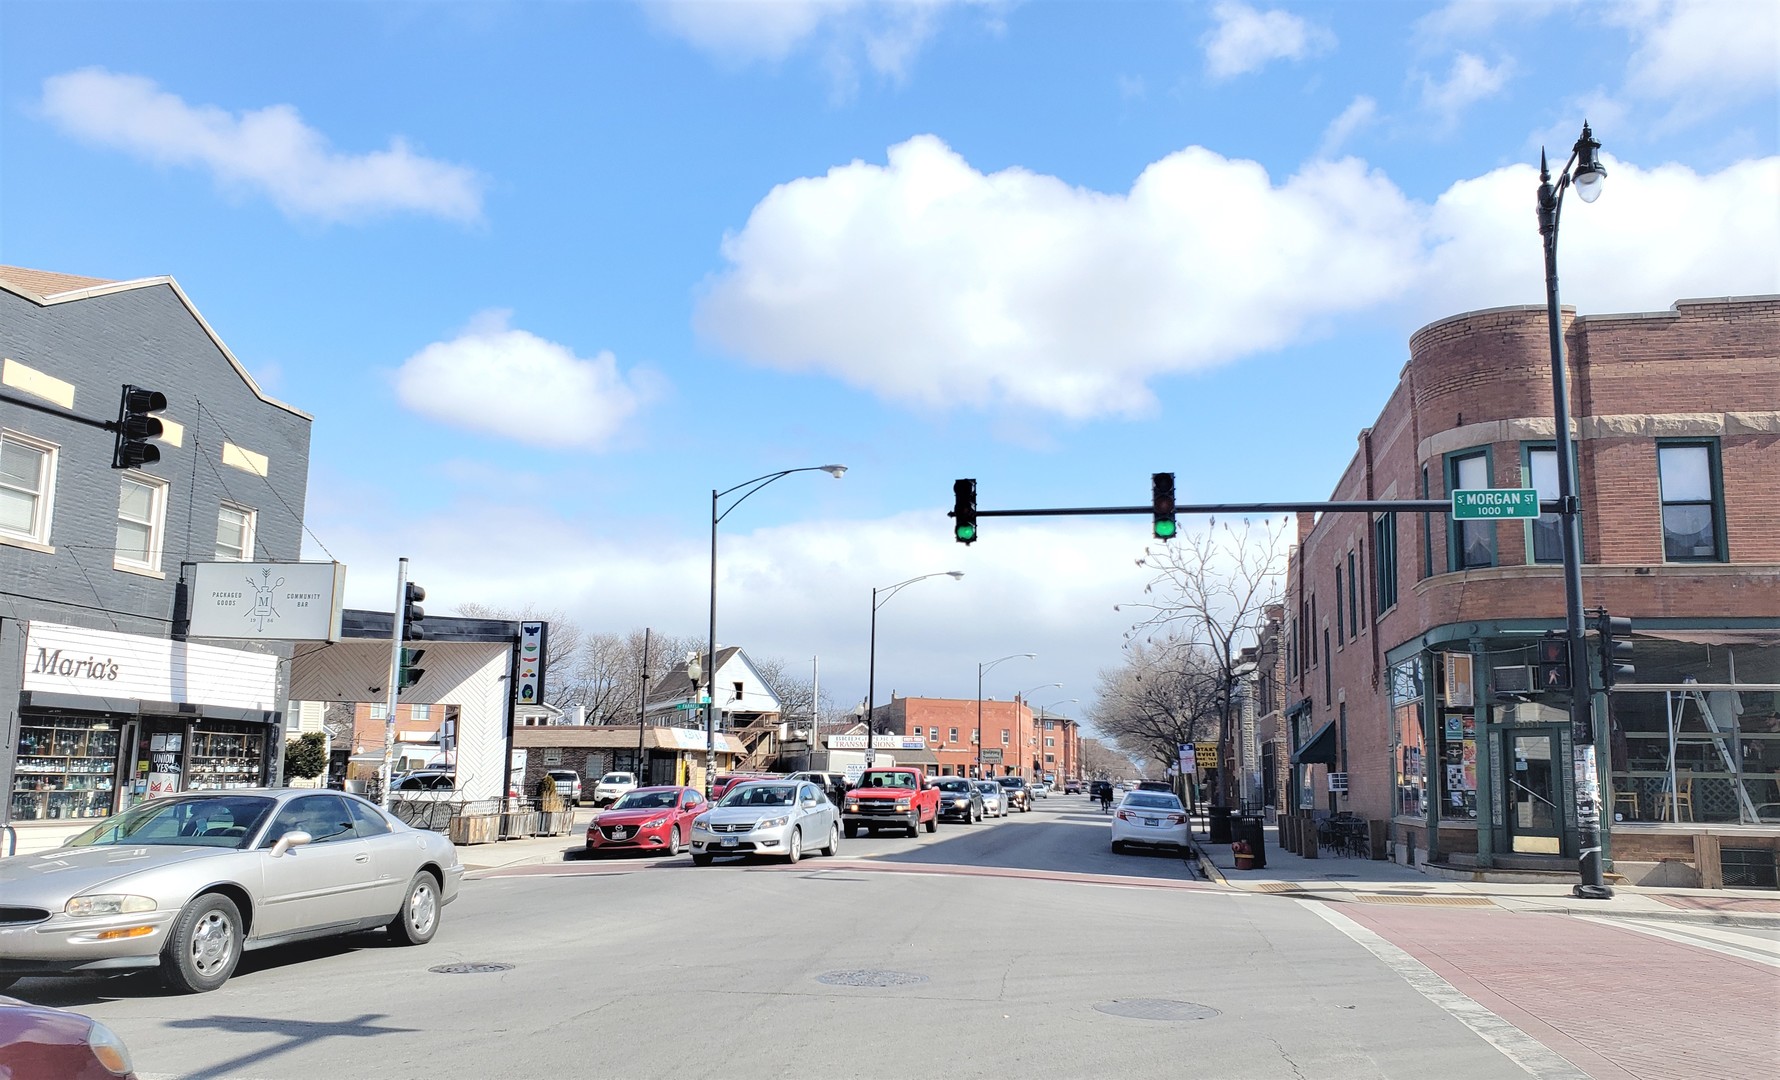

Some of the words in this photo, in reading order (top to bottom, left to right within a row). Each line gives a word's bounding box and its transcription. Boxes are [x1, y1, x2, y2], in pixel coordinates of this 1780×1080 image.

[1466, 493, 1520, 505] MORGAN
[1524, 494, 1534, 502] ST
[1478, 506, 1500, 515] 1000
[1506, 506, 1515, 515] W
[258, 596, 269, 607] M
[32, 647, 119, 681] Maria's
[153, 753, 175, 764] UNION
[156, 763, 169, 773] YES
